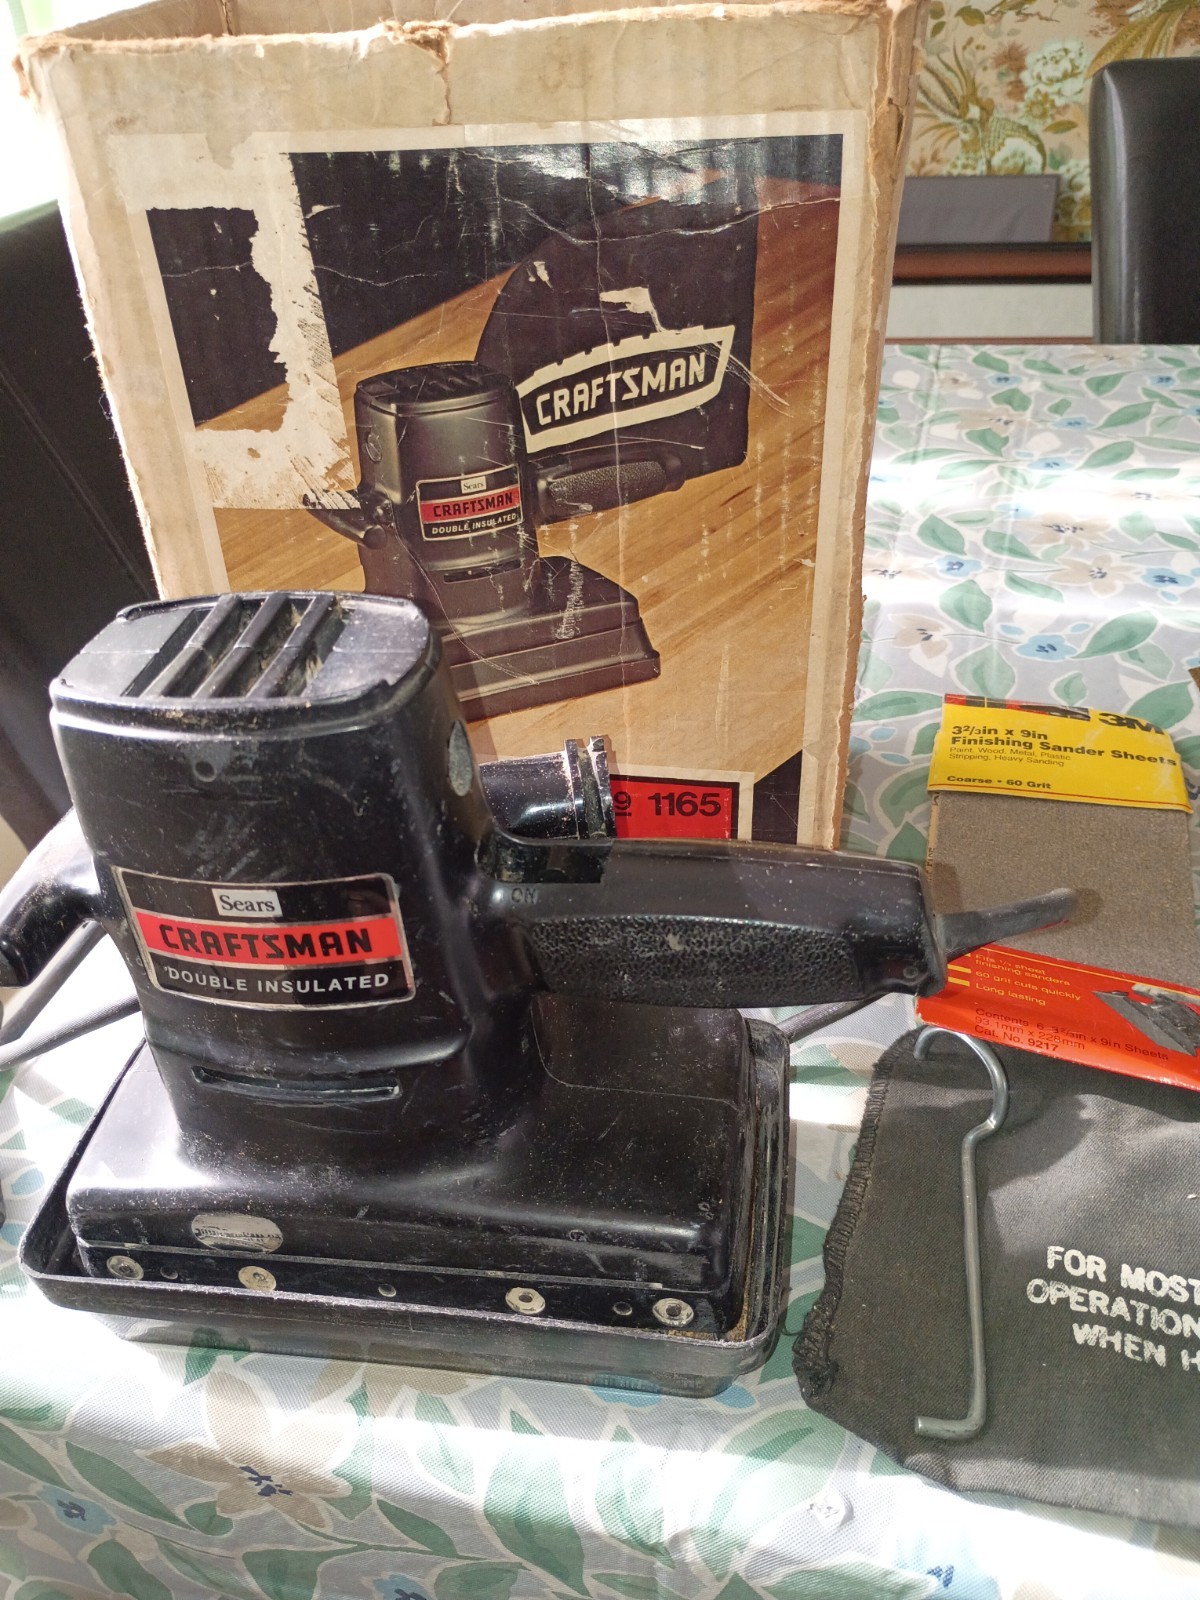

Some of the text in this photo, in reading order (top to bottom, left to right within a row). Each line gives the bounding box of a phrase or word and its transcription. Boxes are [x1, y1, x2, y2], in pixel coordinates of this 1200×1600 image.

[535, 352, 706, 426] CRAFTSMAN
[463, 481, 484, 491] Sears
[433, 492, 513, 517] CRAFTSMAN
[432, 513, 517, 534] DOUBLE INSULATED
[1020, 729, 1048, 740] 9in
[1099, 712, 1165, 735] 3M
[951, 736, 1177, 766] Finishing Sander Sheets
[994, 755, 1023, 763] Heavy
[1026, 756, 1065, 768] Sanding
[1040, 751, 1071, 761] Plastic
[947, 775, 1052, 789] Coarse 60 Grit
[647, 791, 722, 817] 1165
[218, 894, 275, 913] Sears
[158, 923, 373, 960] CRAFTSMAN
[165, 966, 390, 993] DOUBLE INSULATED
[975, 959, 1071, 986] finishing sanders
[1014, 963, 1047, 976] sheet
[975, 971, 1081, 1001] 60 grit cuts quickly
[975, 983, 1046, 1006] Long lasting
[974, 1024, 1059, 1052] Cat. No. 9217
[1100, 1038, 1121, 1049] 9in
[1124, 1043, 1169, 1061] Sheets
[1046, 1245, 1200, 1306] FOR MOST
[1072, 1322, 1167, 1368] WHEN
